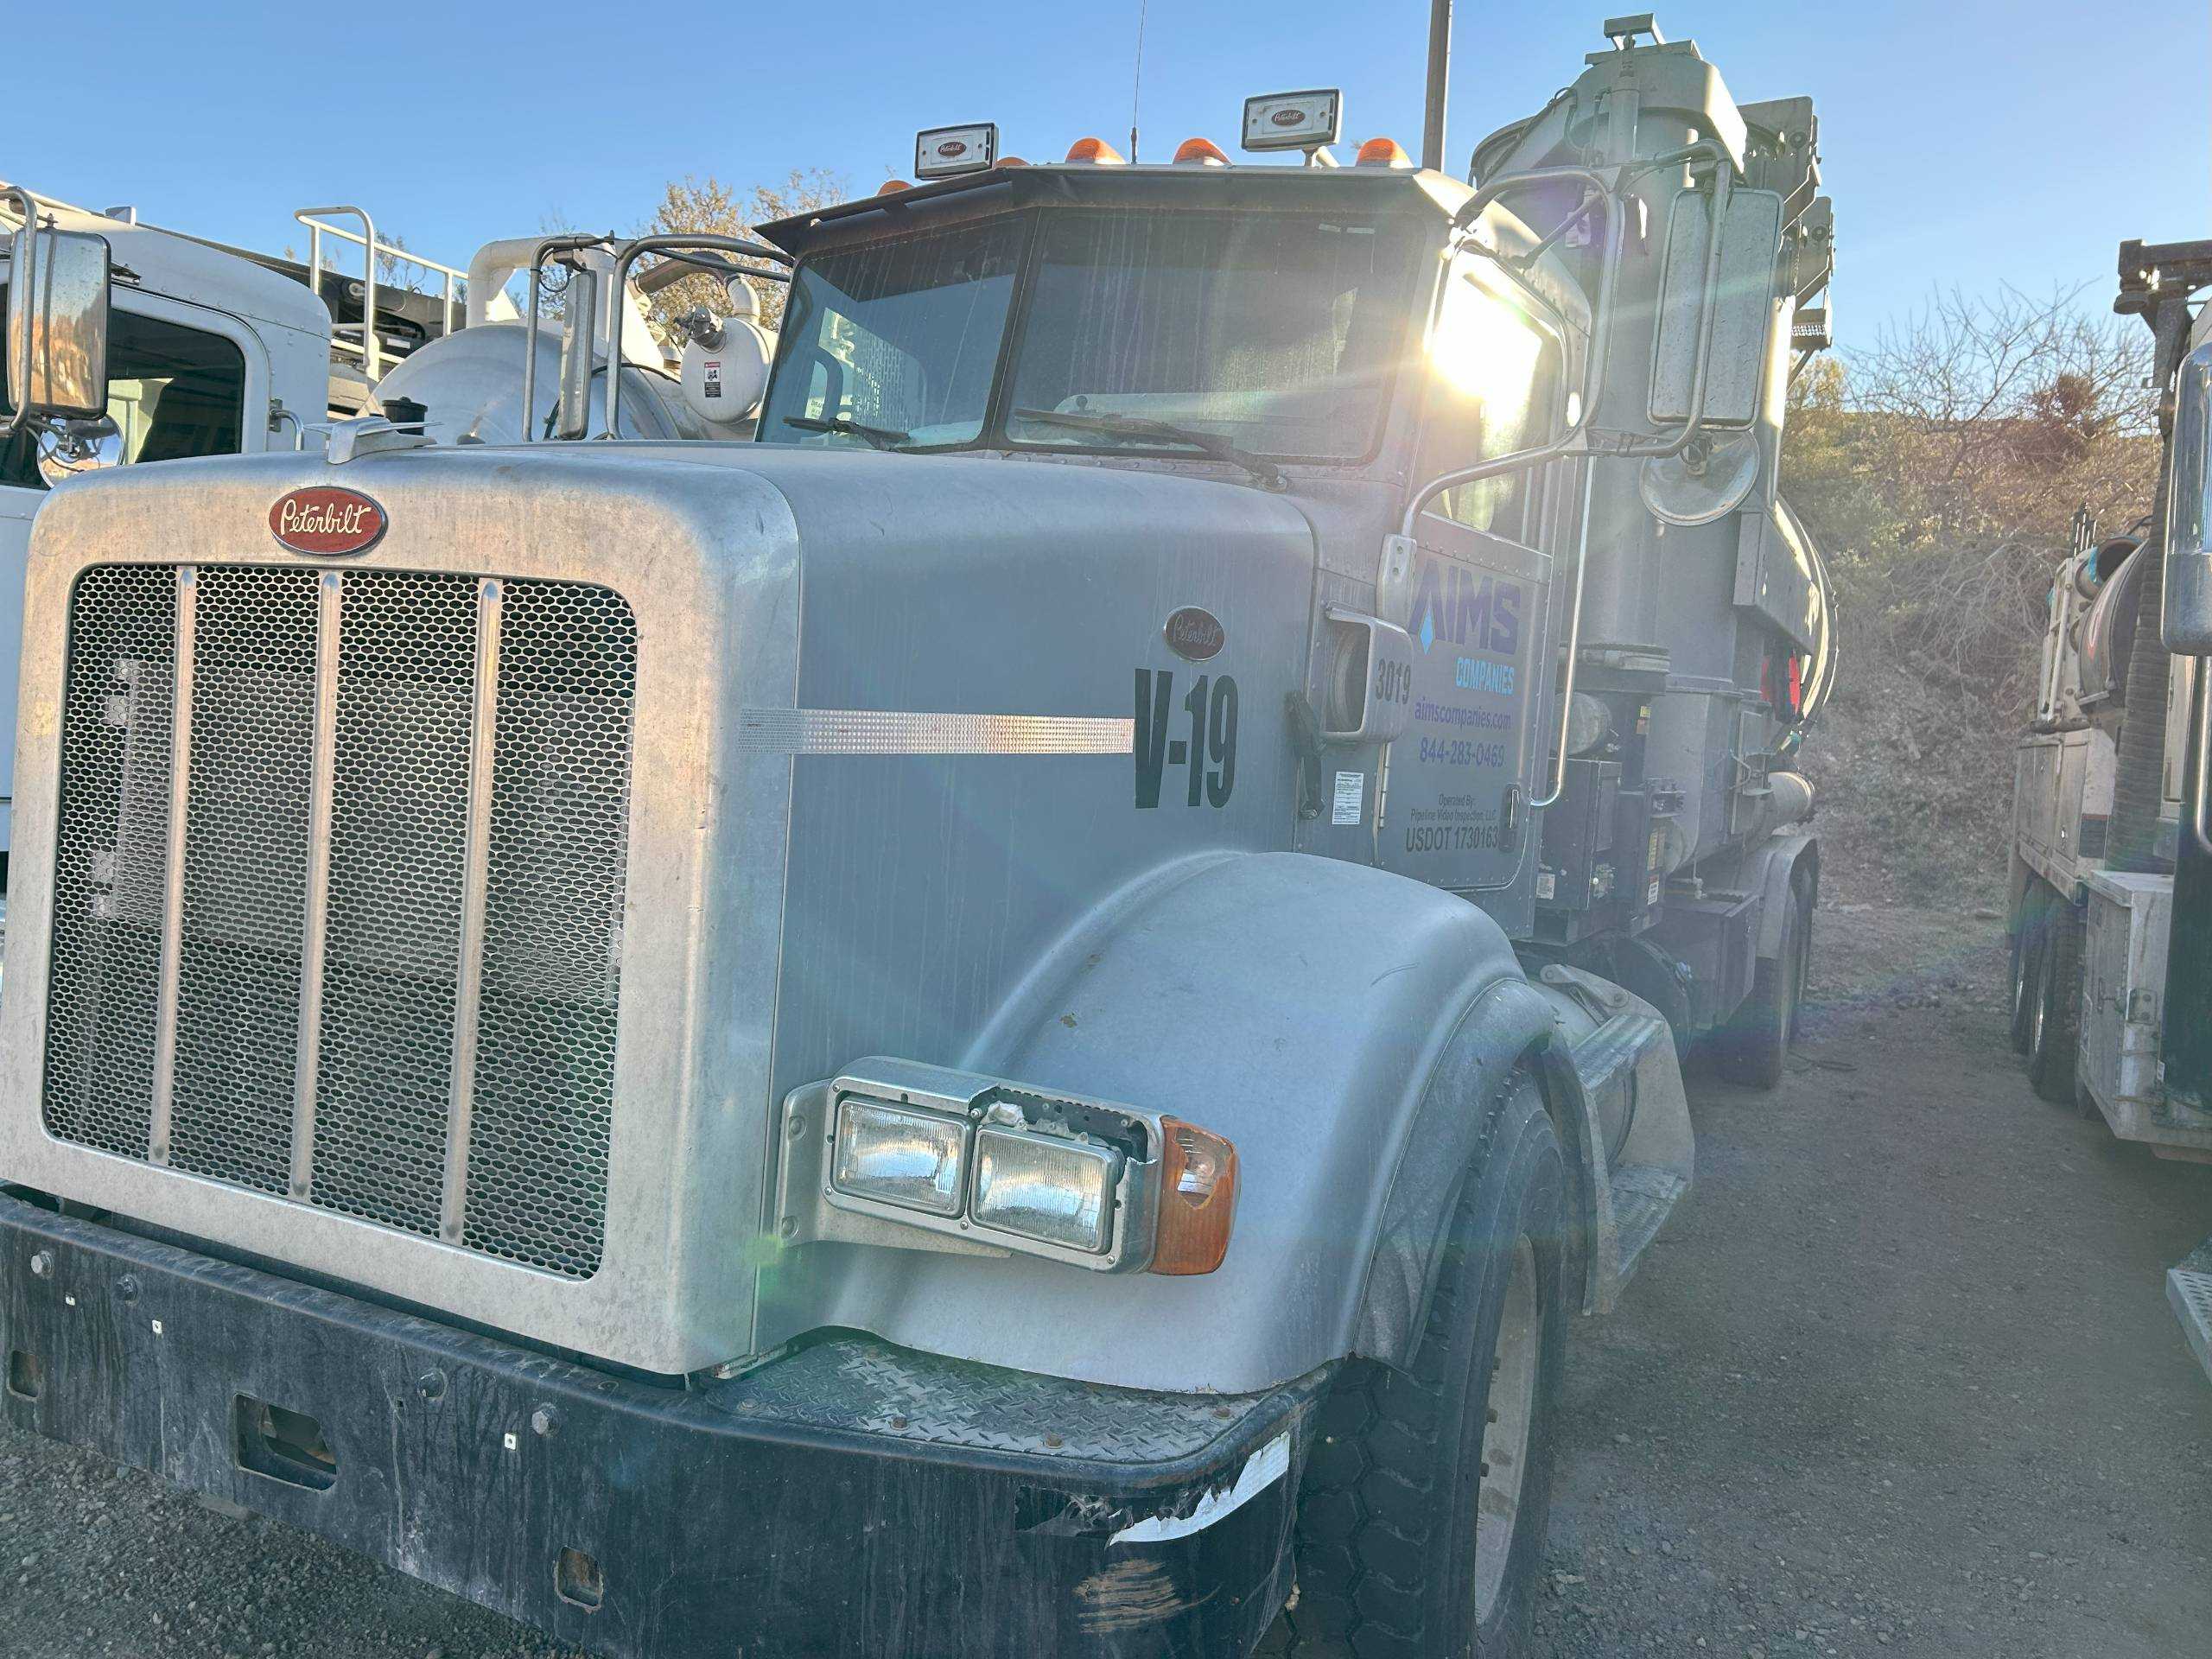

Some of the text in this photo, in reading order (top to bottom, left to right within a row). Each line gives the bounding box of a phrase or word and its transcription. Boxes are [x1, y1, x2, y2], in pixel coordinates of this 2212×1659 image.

[280, 499, 372, 536] Peterbilt
[1408, 559, 1521, 655] AIMS
[1173, 613, 1221, 648] Peterbilt
[1376, 658, 1411, 705] 3019
[1454, 656, 1515, 697] COMPANIES
[1414, 695, 1513, 731] aimscompanies.com
[1135, 668, 1239, 809] V-19
[1419, 736, 1506, 768] 844-283-0469
[1406, 826, 1499, 852] USDOT 1730163
